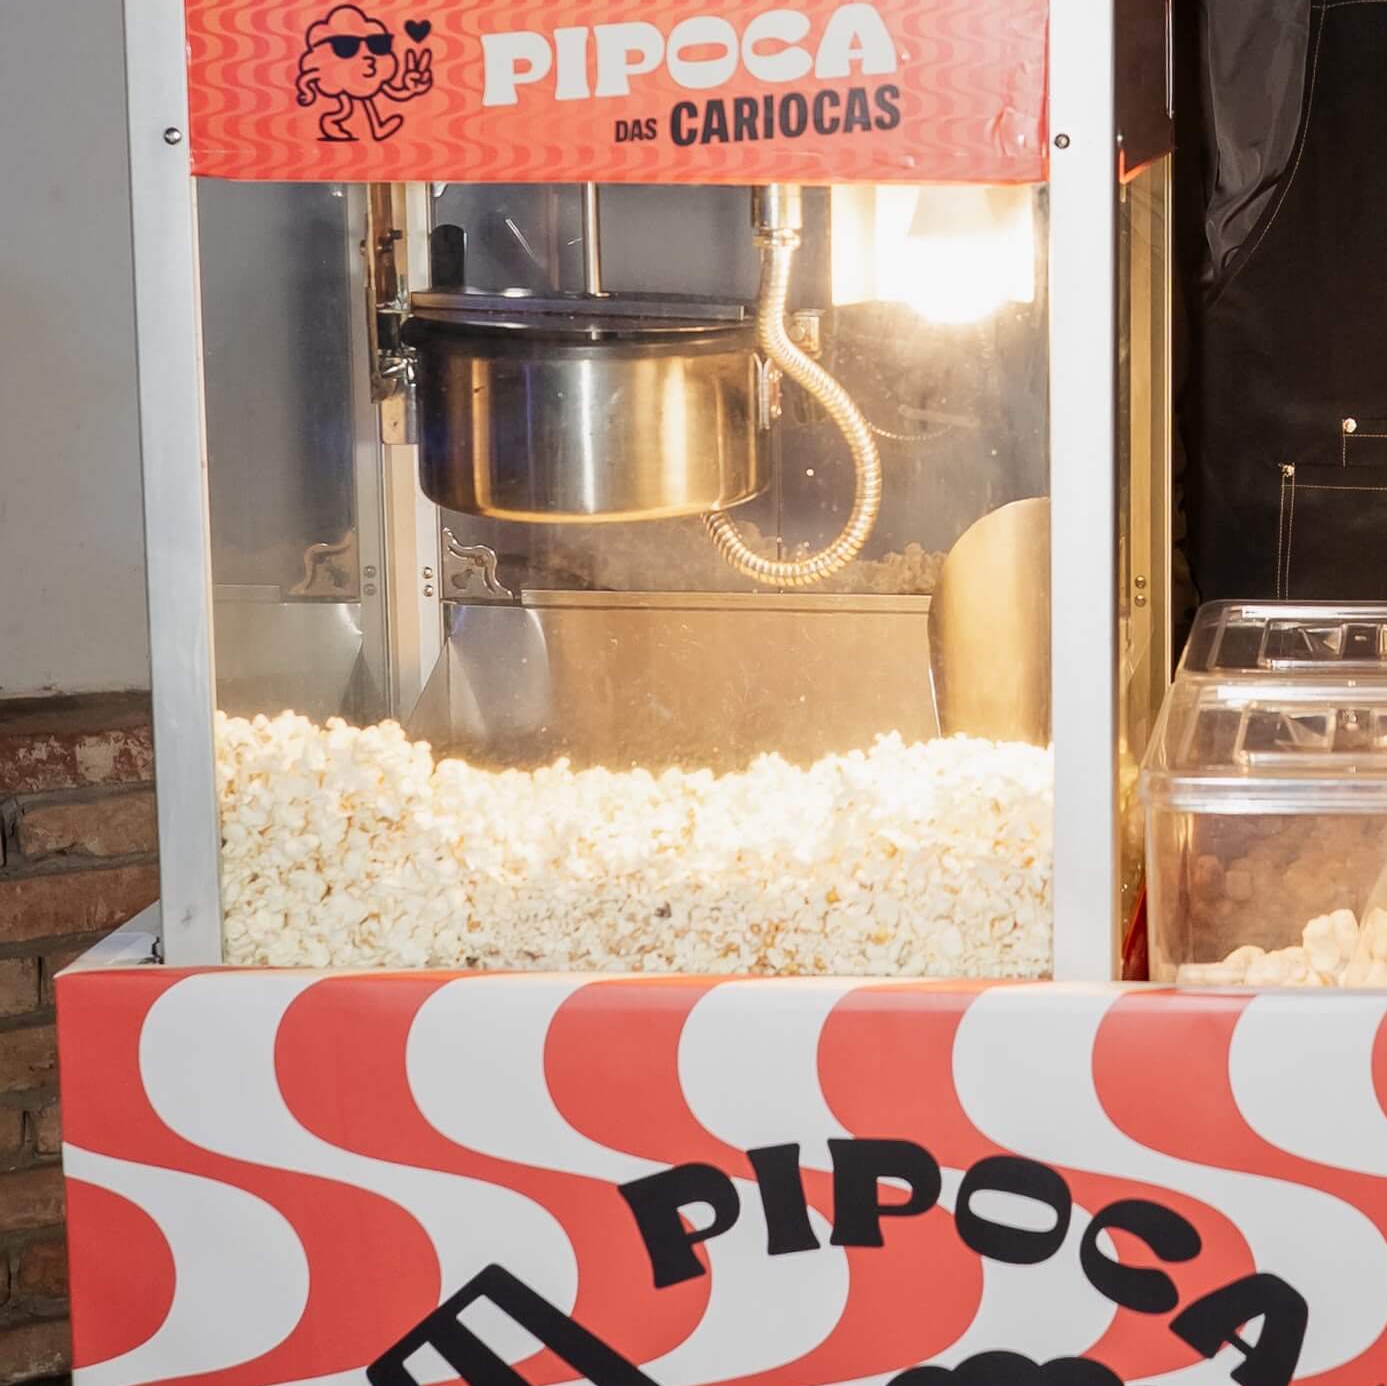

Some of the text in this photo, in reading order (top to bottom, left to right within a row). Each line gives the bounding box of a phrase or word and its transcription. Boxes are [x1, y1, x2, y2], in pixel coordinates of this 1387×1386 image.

[480, 3, 898, 107] PIPOCA
[614, 84, 901, 148] DAS CARIOCAS
